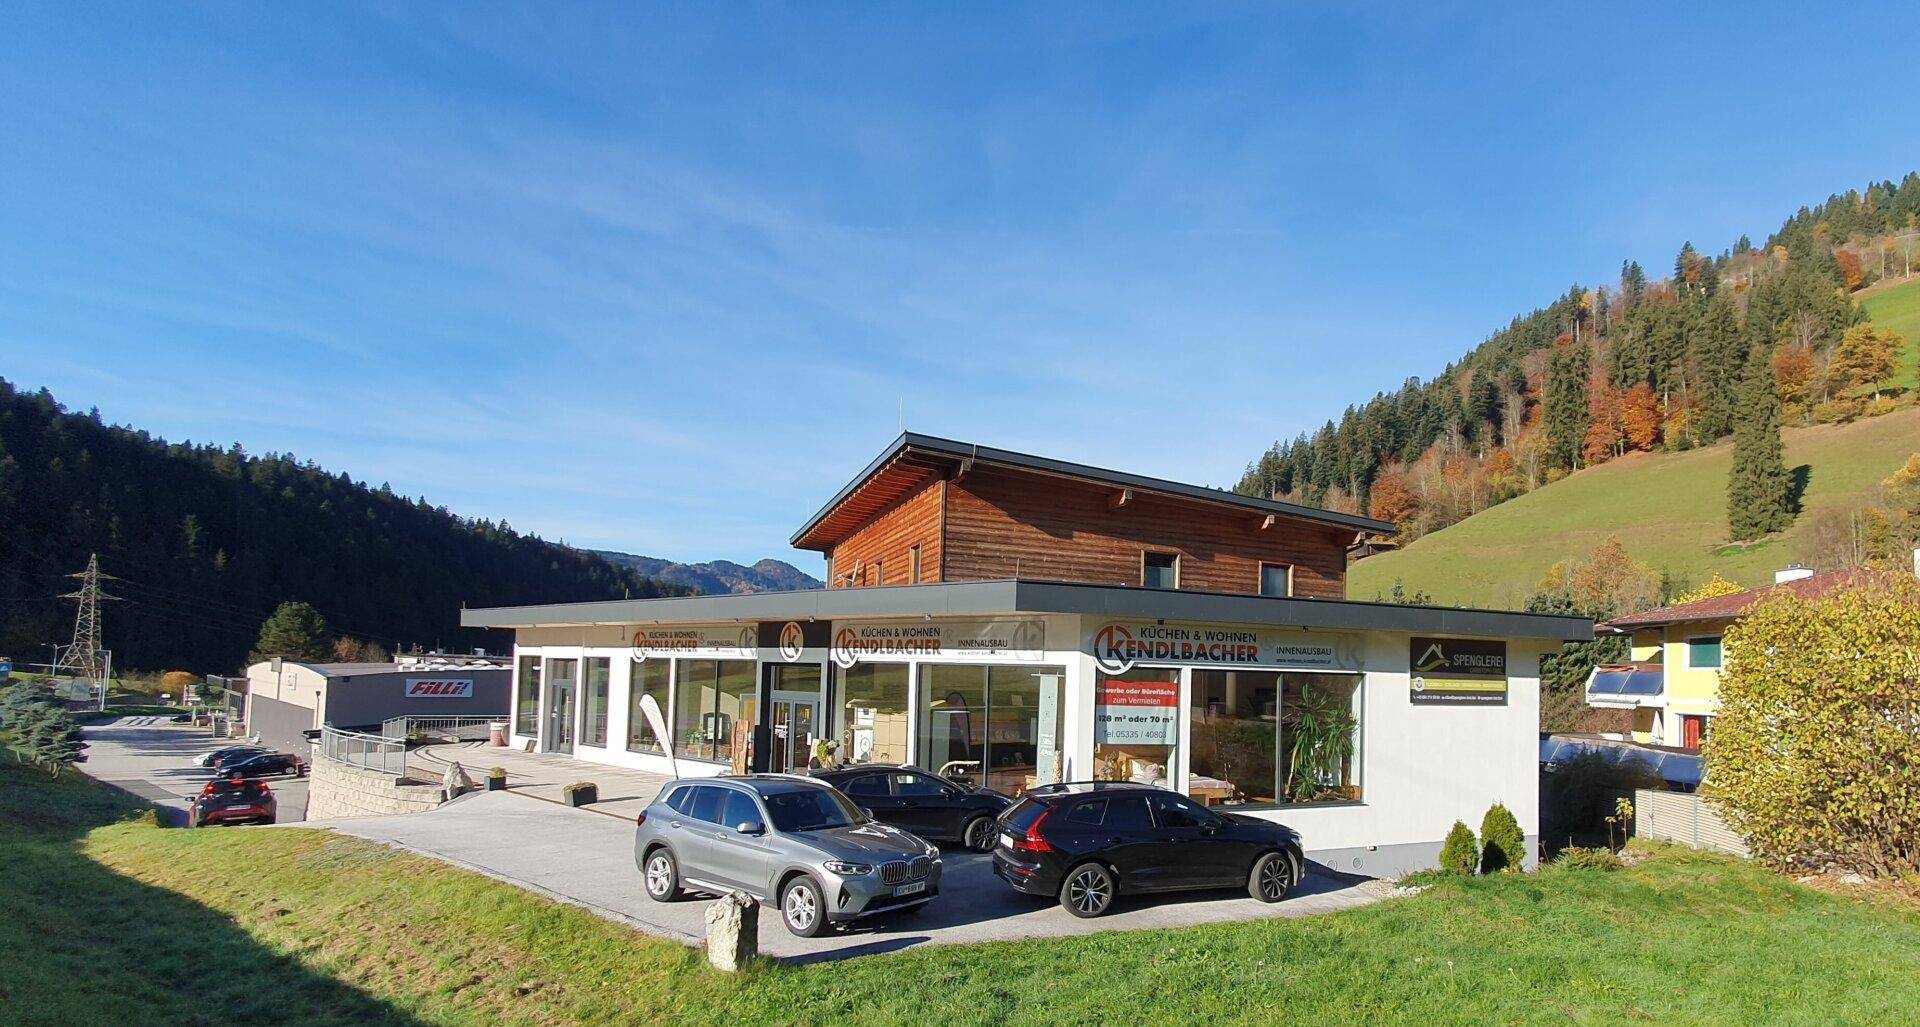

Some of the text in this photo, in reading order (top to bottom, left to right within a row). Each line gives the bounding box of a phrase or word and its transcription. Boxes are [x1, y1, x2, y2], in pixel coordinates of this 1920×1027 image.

[861, 626, 941, 638] KÜCHEN & WOHNEN
[1140, 626, 1257, 643] KÜCHEN & WOHNEN
[634, 634, 698, 654] KENDLBACHER
[840, 633, 942, 656] KENDLBACHER
[958, 639, 1008, 648] INNENAUSBAU
[1104, 630, 1259, 664] KENDLBACHER
[1276, 646, 1332, 656] INNENAUSBAU
[1453, 654, 1504, 667] SPENGLEREI
[1125, 687, 1141, 695] oder
[1128, 697, 1161, 705] Vermieten
[1098, 715, 1112, 723] 128
[1114, 715, 1127, 723] m²
[1128, 715, 1148, 723] oder
[1162, 716, 1174, 724] m²
